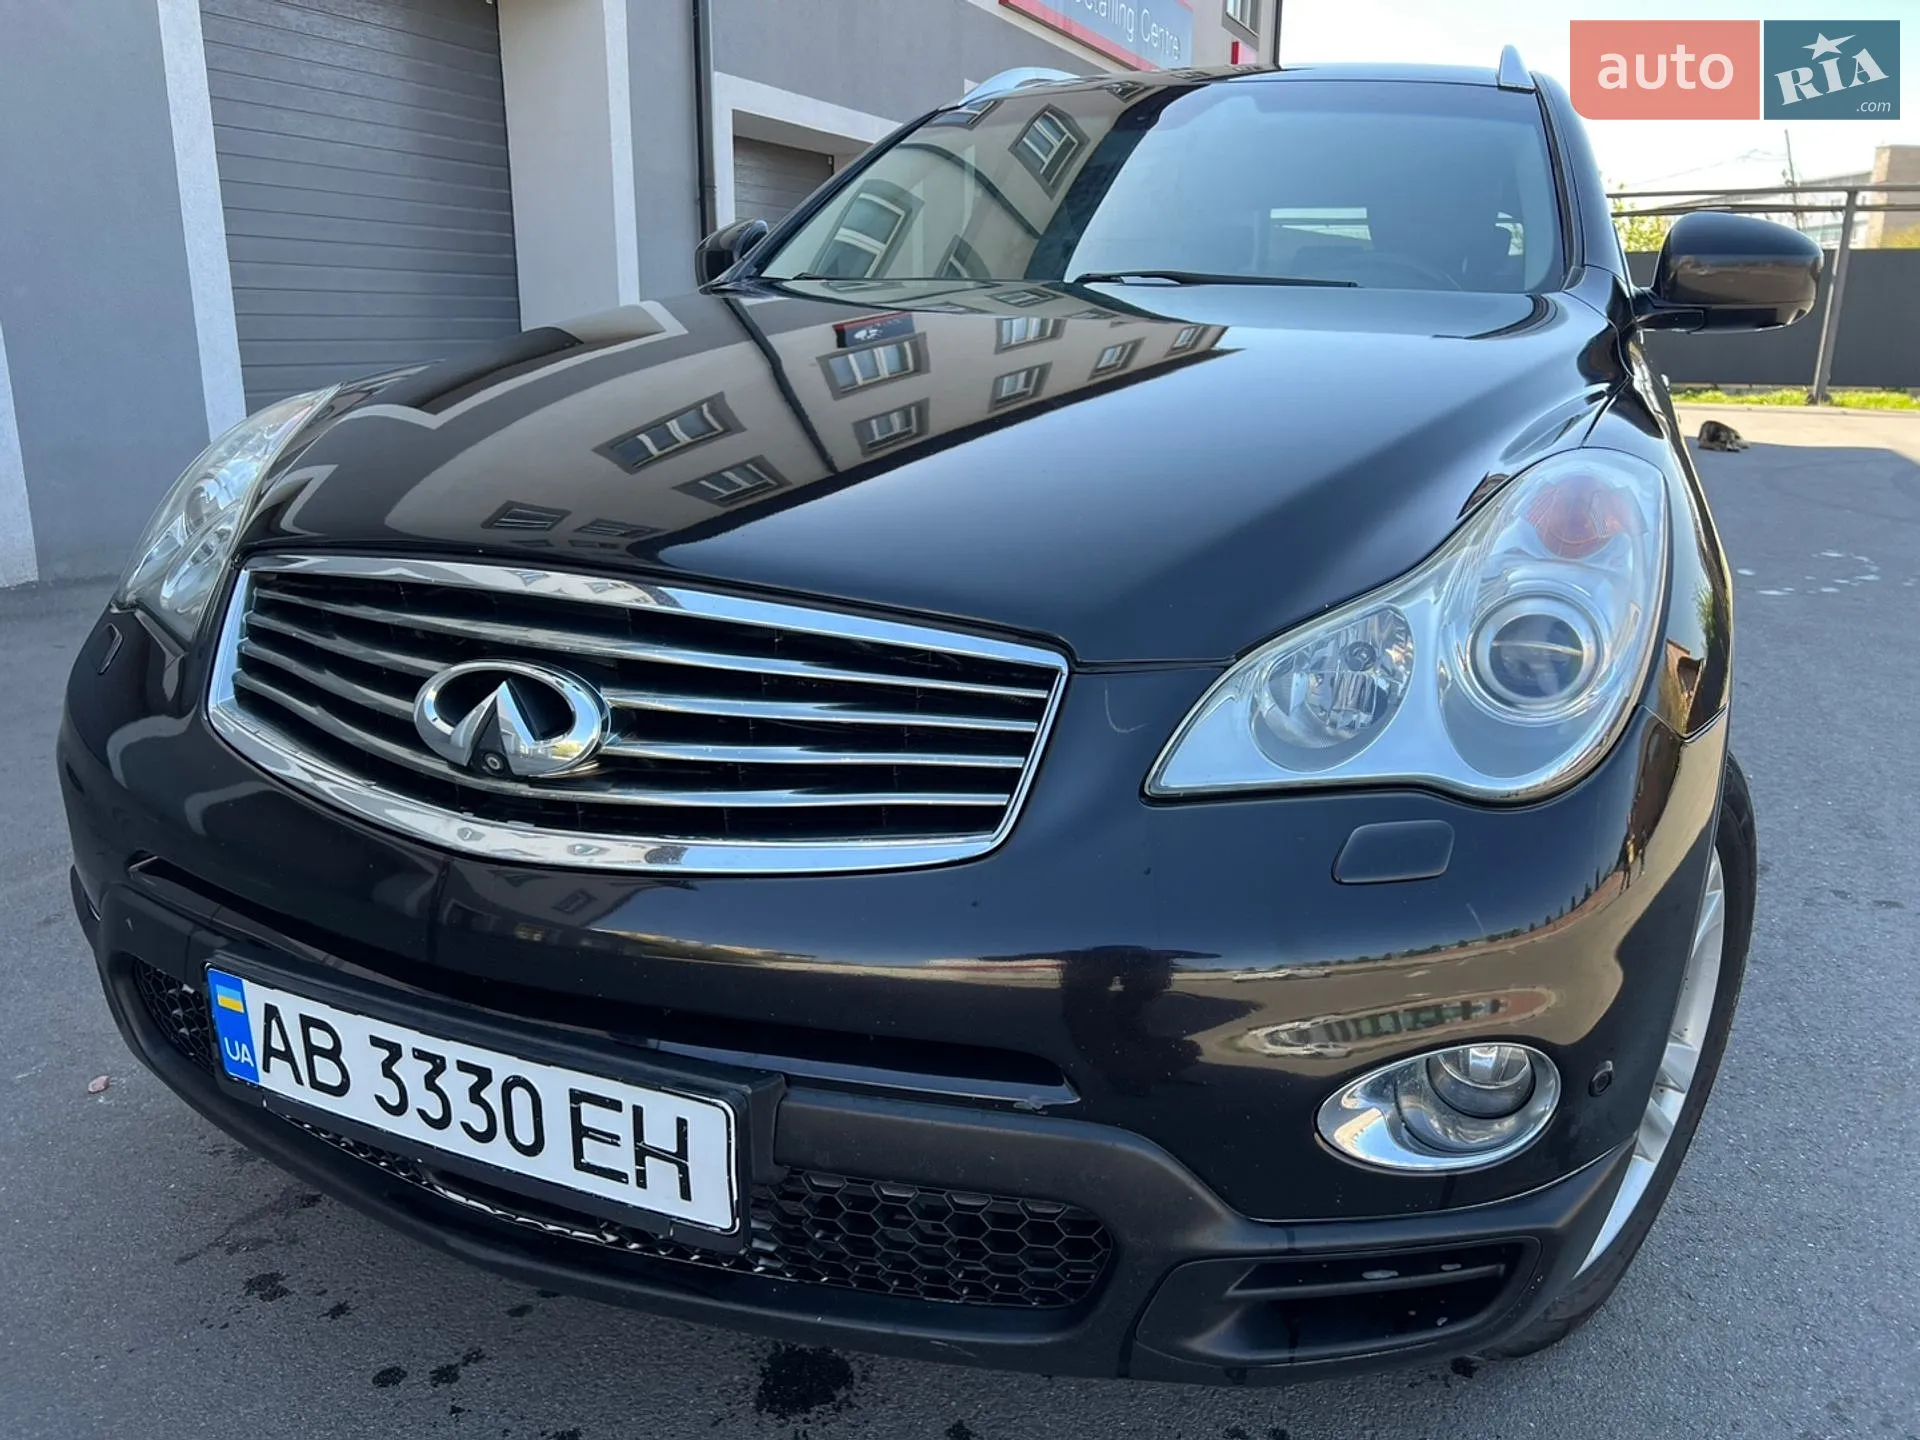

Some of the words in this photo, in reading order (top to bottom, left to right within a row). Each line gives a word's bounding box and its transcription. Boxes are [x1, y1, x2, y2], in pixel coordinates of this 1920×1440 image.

[1075, 0, 1135, 42] tailing
[1141, 9, 1181, 60] Centre
[224, 1037, 254, 1068] UA
[262, 1003, 351, 1098] AB
[369, 1034, 544, 1158] 3330
[569, 1088, 692, 1202] EH
